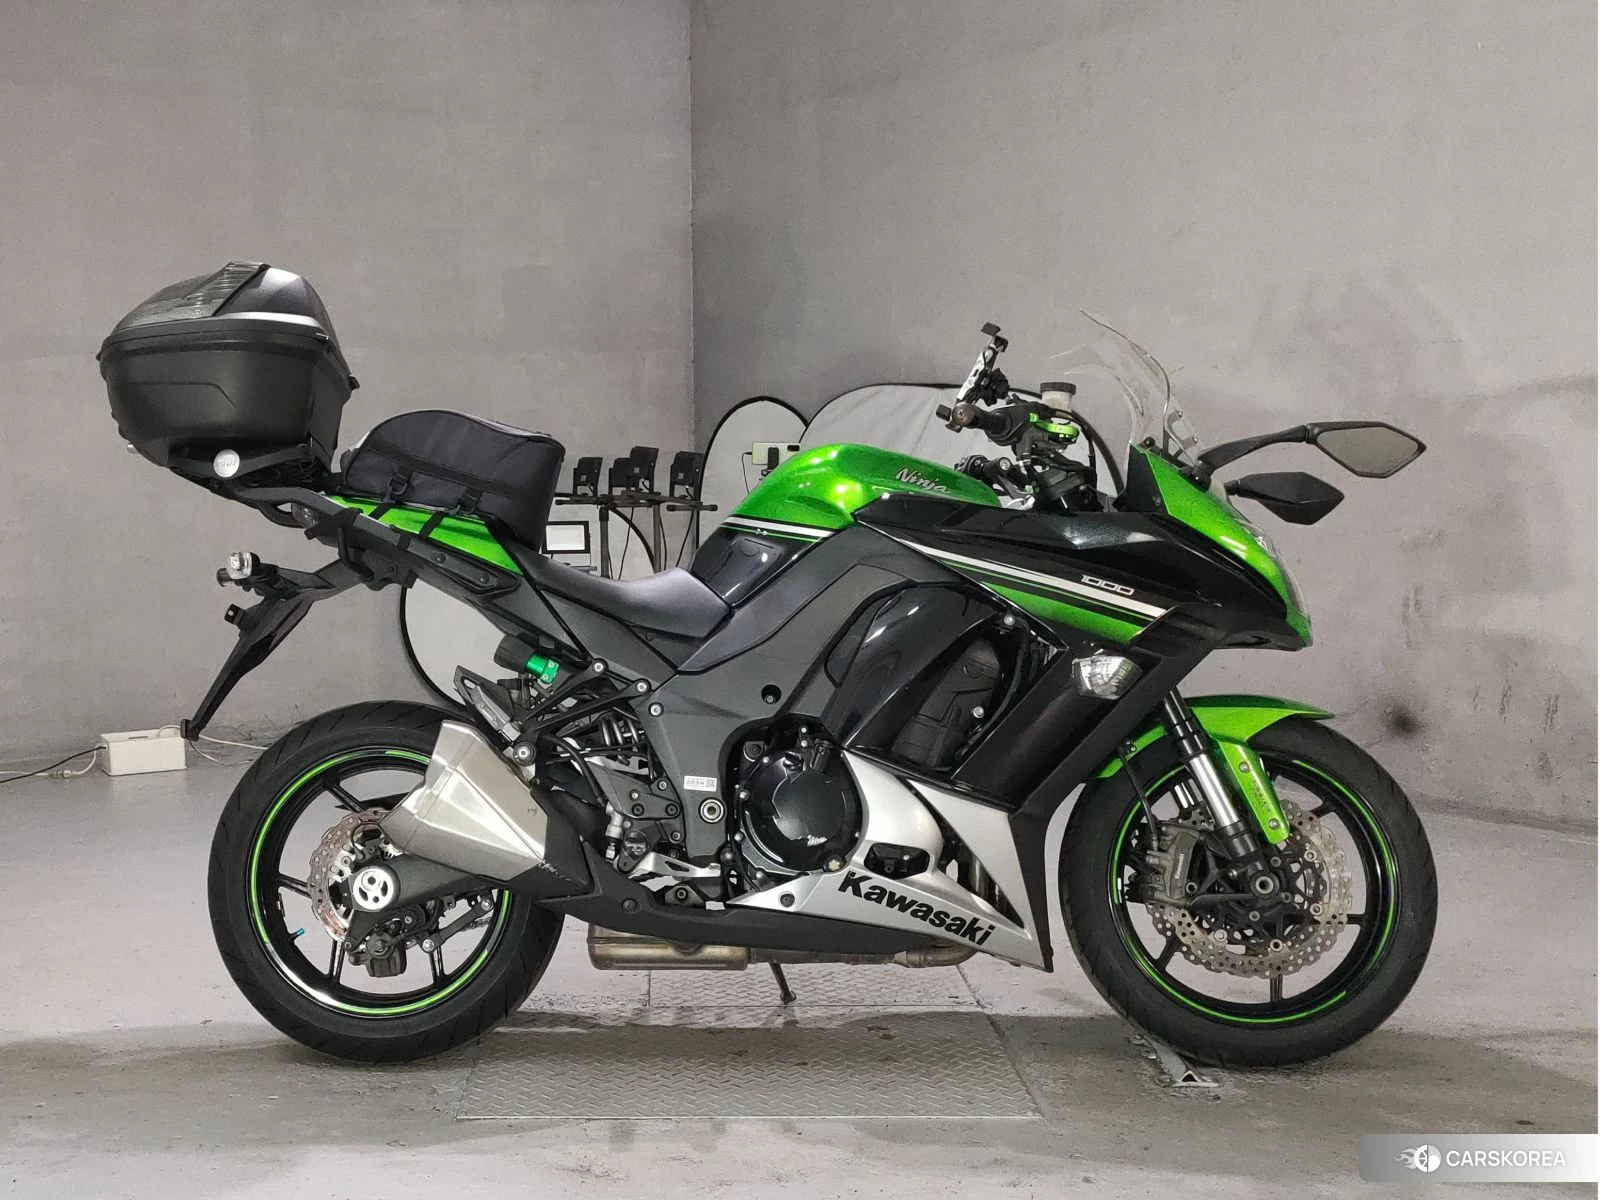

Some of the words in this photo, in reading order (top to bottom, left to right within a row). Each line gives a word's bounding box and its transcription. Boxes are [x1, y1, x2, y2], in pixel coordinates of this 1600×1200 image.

[895, 468, 948, 493] Ninja
[1081, 574, 1135, 596] 1000
[838, 870, 996, 946] Kawasaki
